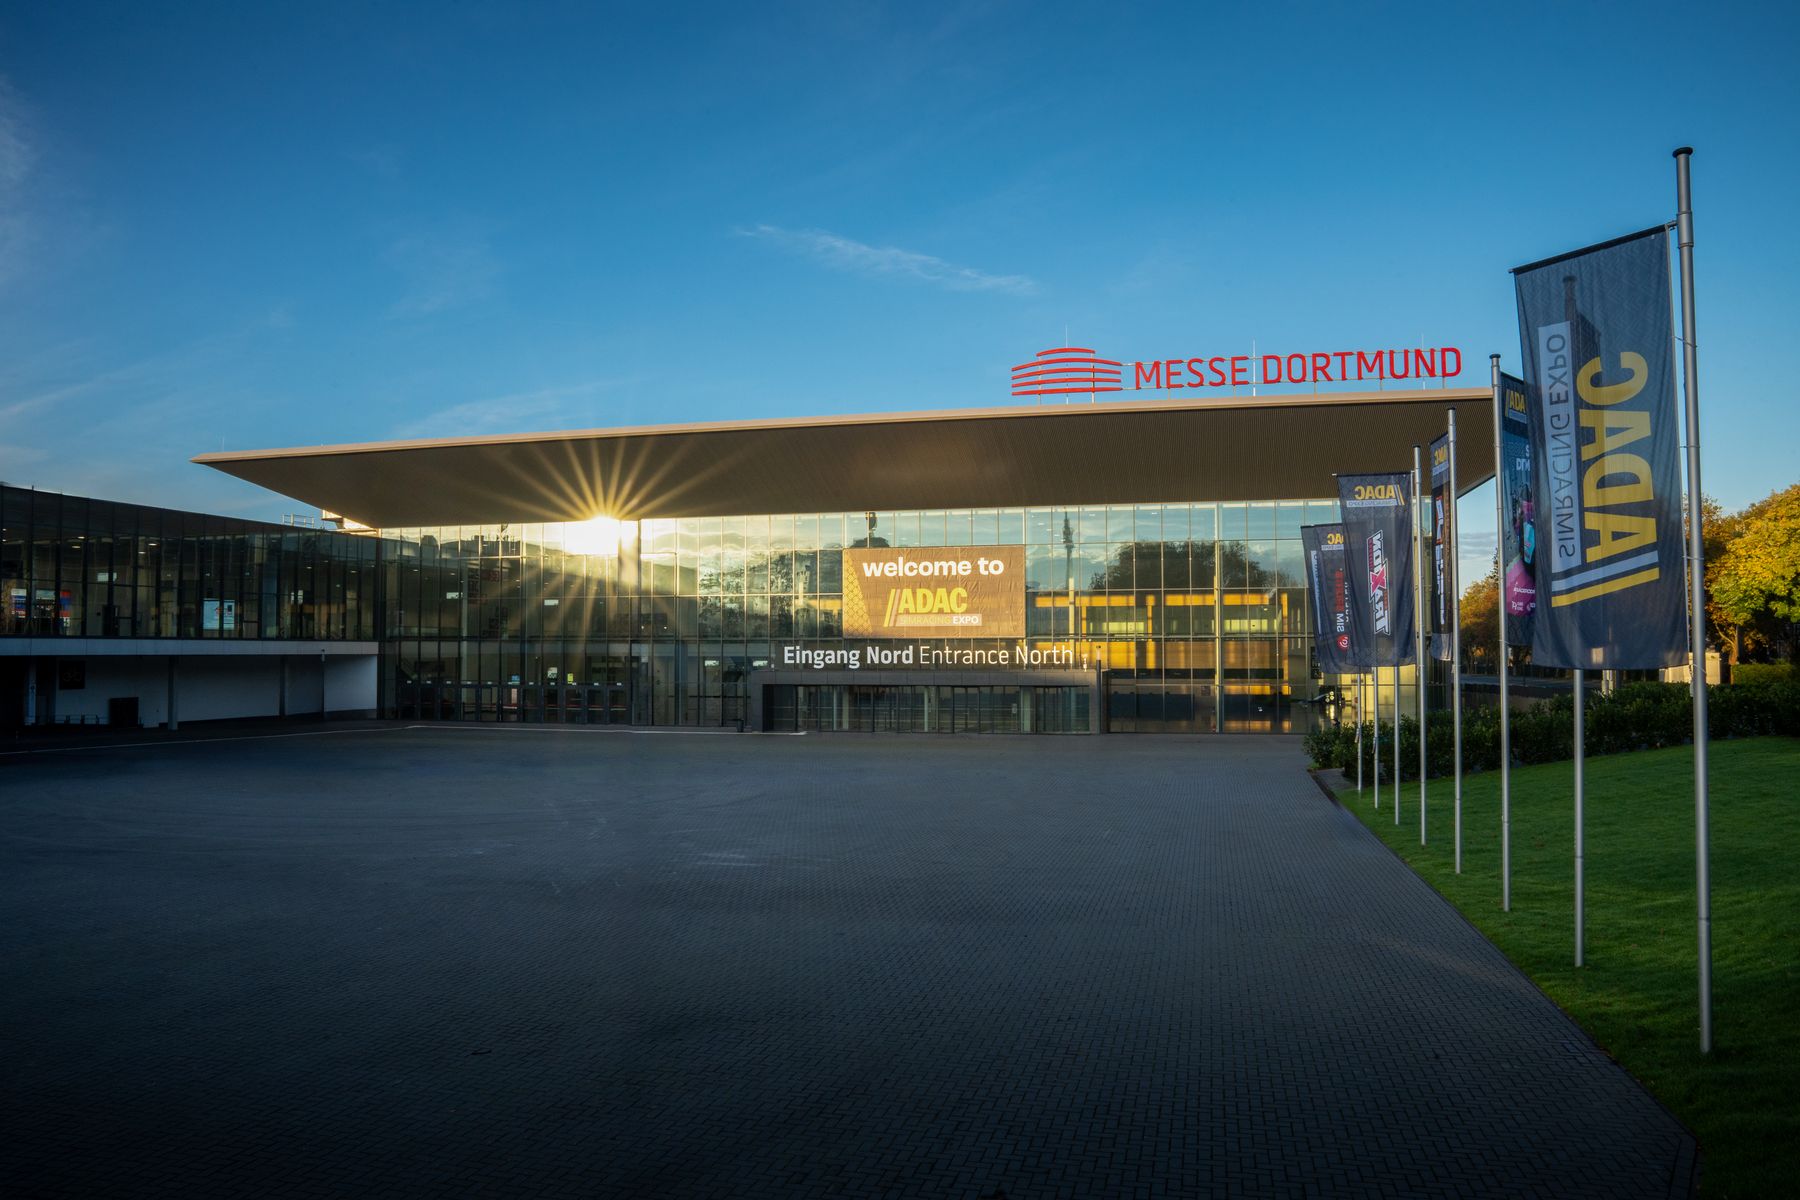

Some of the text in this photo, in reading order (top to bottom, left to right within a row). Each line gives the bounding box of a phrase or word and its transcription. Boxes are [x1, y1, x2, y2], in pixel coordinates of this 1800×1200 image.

[1135, 347, 1462, 390] MESSE DORTMUND
[1509, 390, 1526, 413] ADA
[862, 556, 1005, 577] welcome to
[898, 587, 968, 614] ADAC
[899, 615, 979, 624] SIMRACING EXPO
[784, 645, 1073, 669] Eingang Nord Entrance North
